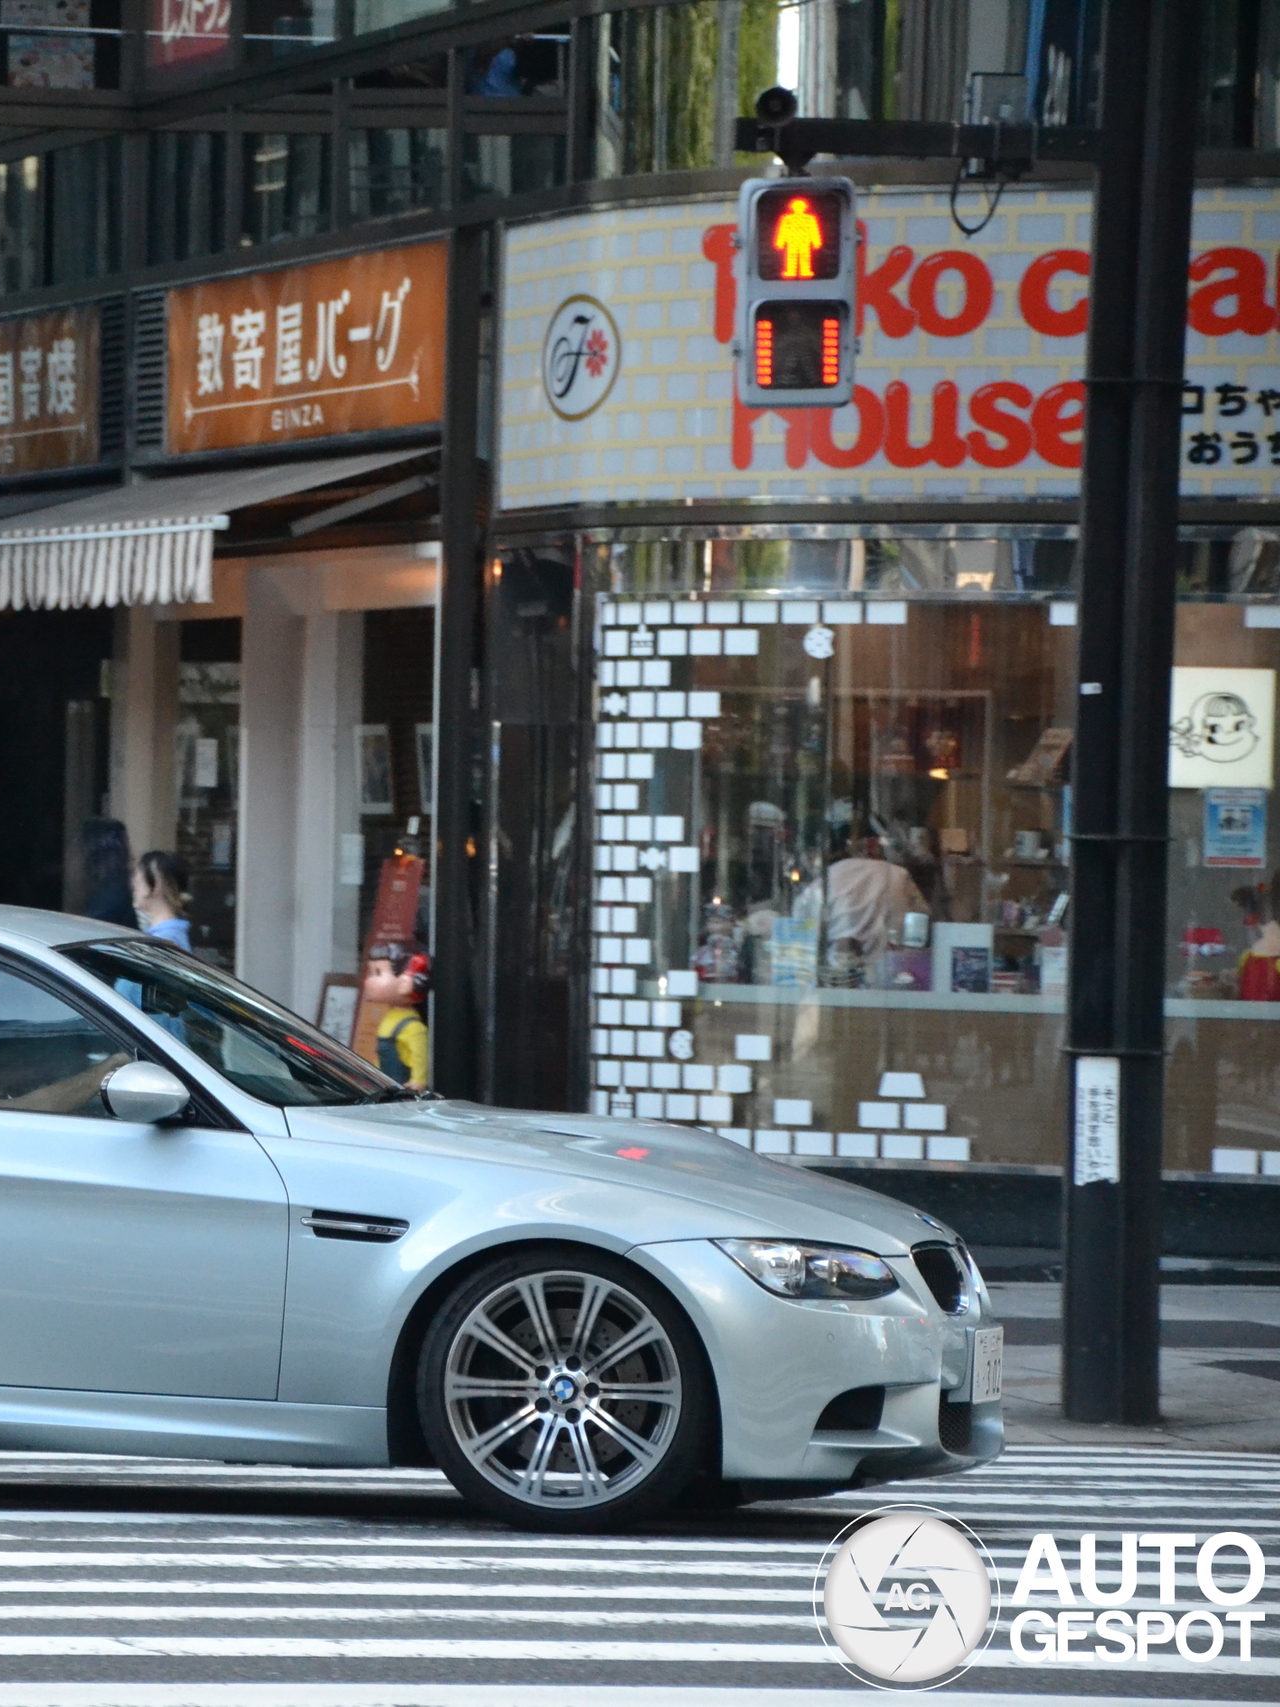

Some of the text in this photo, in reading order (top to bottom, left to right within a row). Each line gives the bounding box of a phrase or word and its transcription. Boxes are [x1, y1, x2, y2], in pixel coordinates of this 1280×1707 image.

[196, 276, 413, 396] 数寄屋バーグ
[270, 403, 325, 431] GINZA
